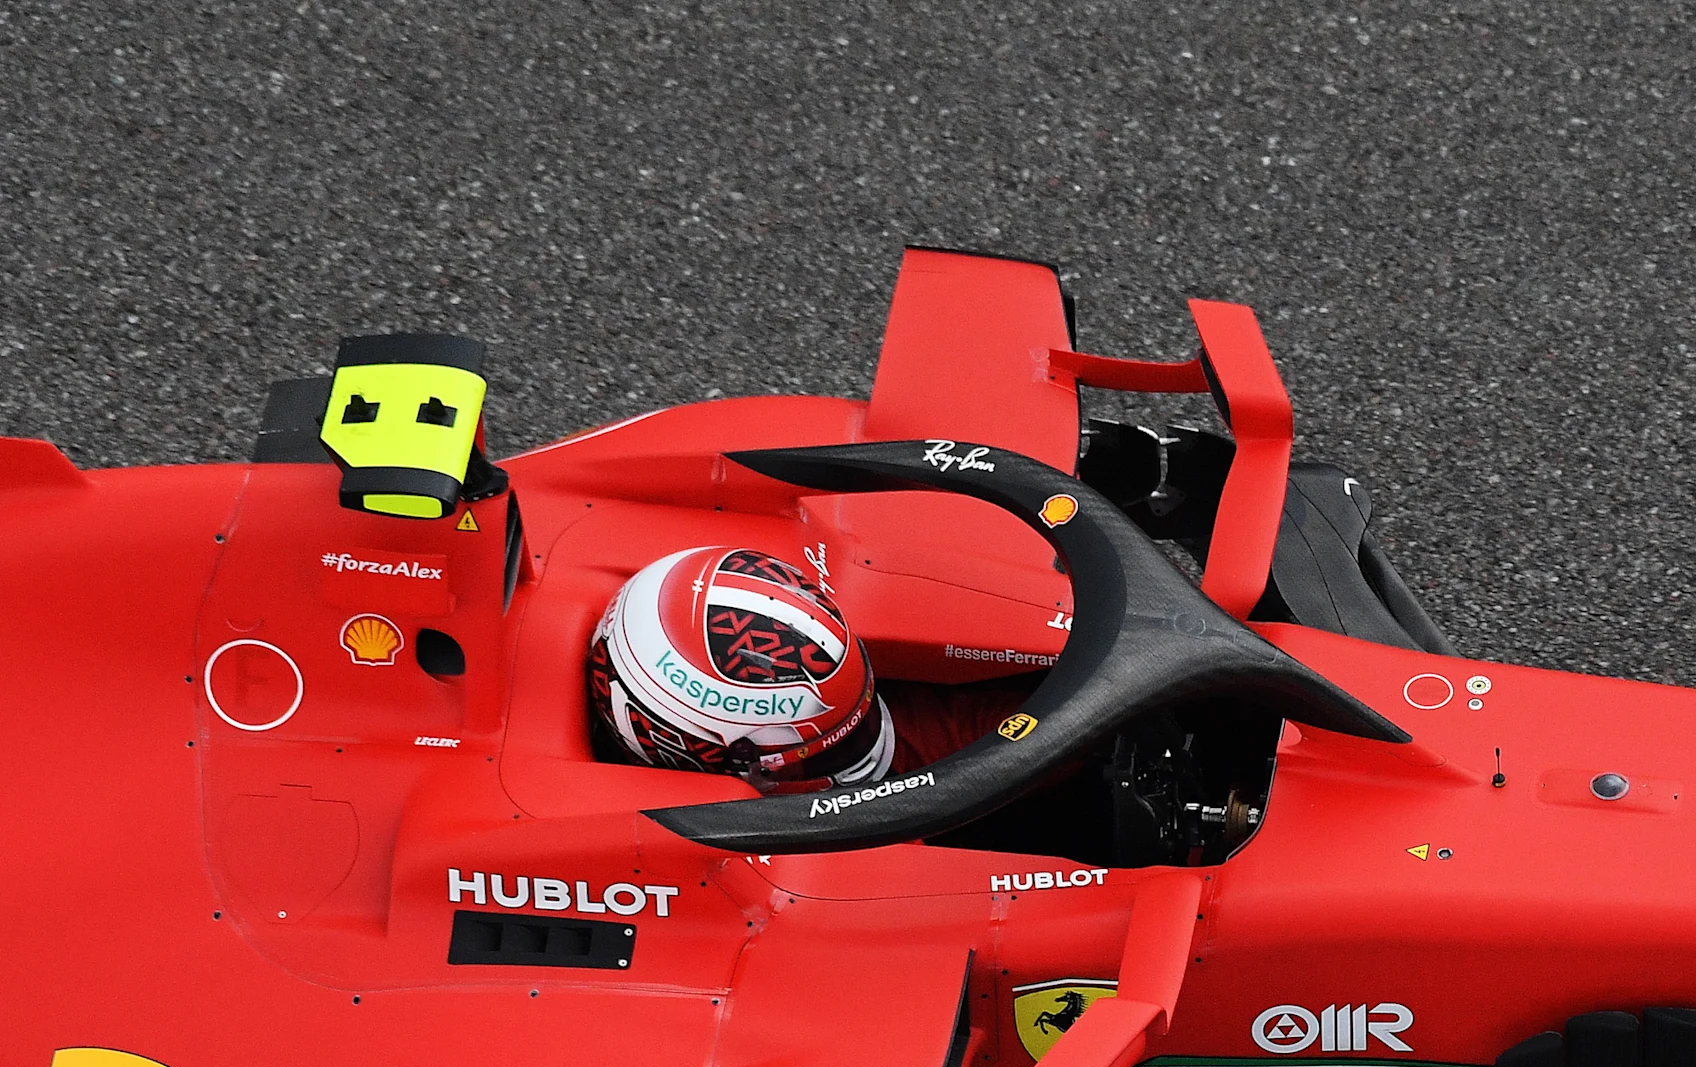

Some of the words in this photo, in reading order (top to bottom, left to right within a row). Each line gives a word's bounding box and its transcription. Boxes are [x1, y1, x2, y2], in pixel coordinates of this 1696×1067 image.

[321, 552, 442, 580] #forzaAlex
[655, 650, 805, 719] kaspersky
[414, 736, 461, 748] LECLERC
[822, 709, 862, 748] HUBLOT
[1001, 716, 1030, 736] ups
[809, 771, 936, 819] kaspersky
[448, 868, 679, 917] HUBLOT
[990, 868, 1109, 892] HUBLOT
